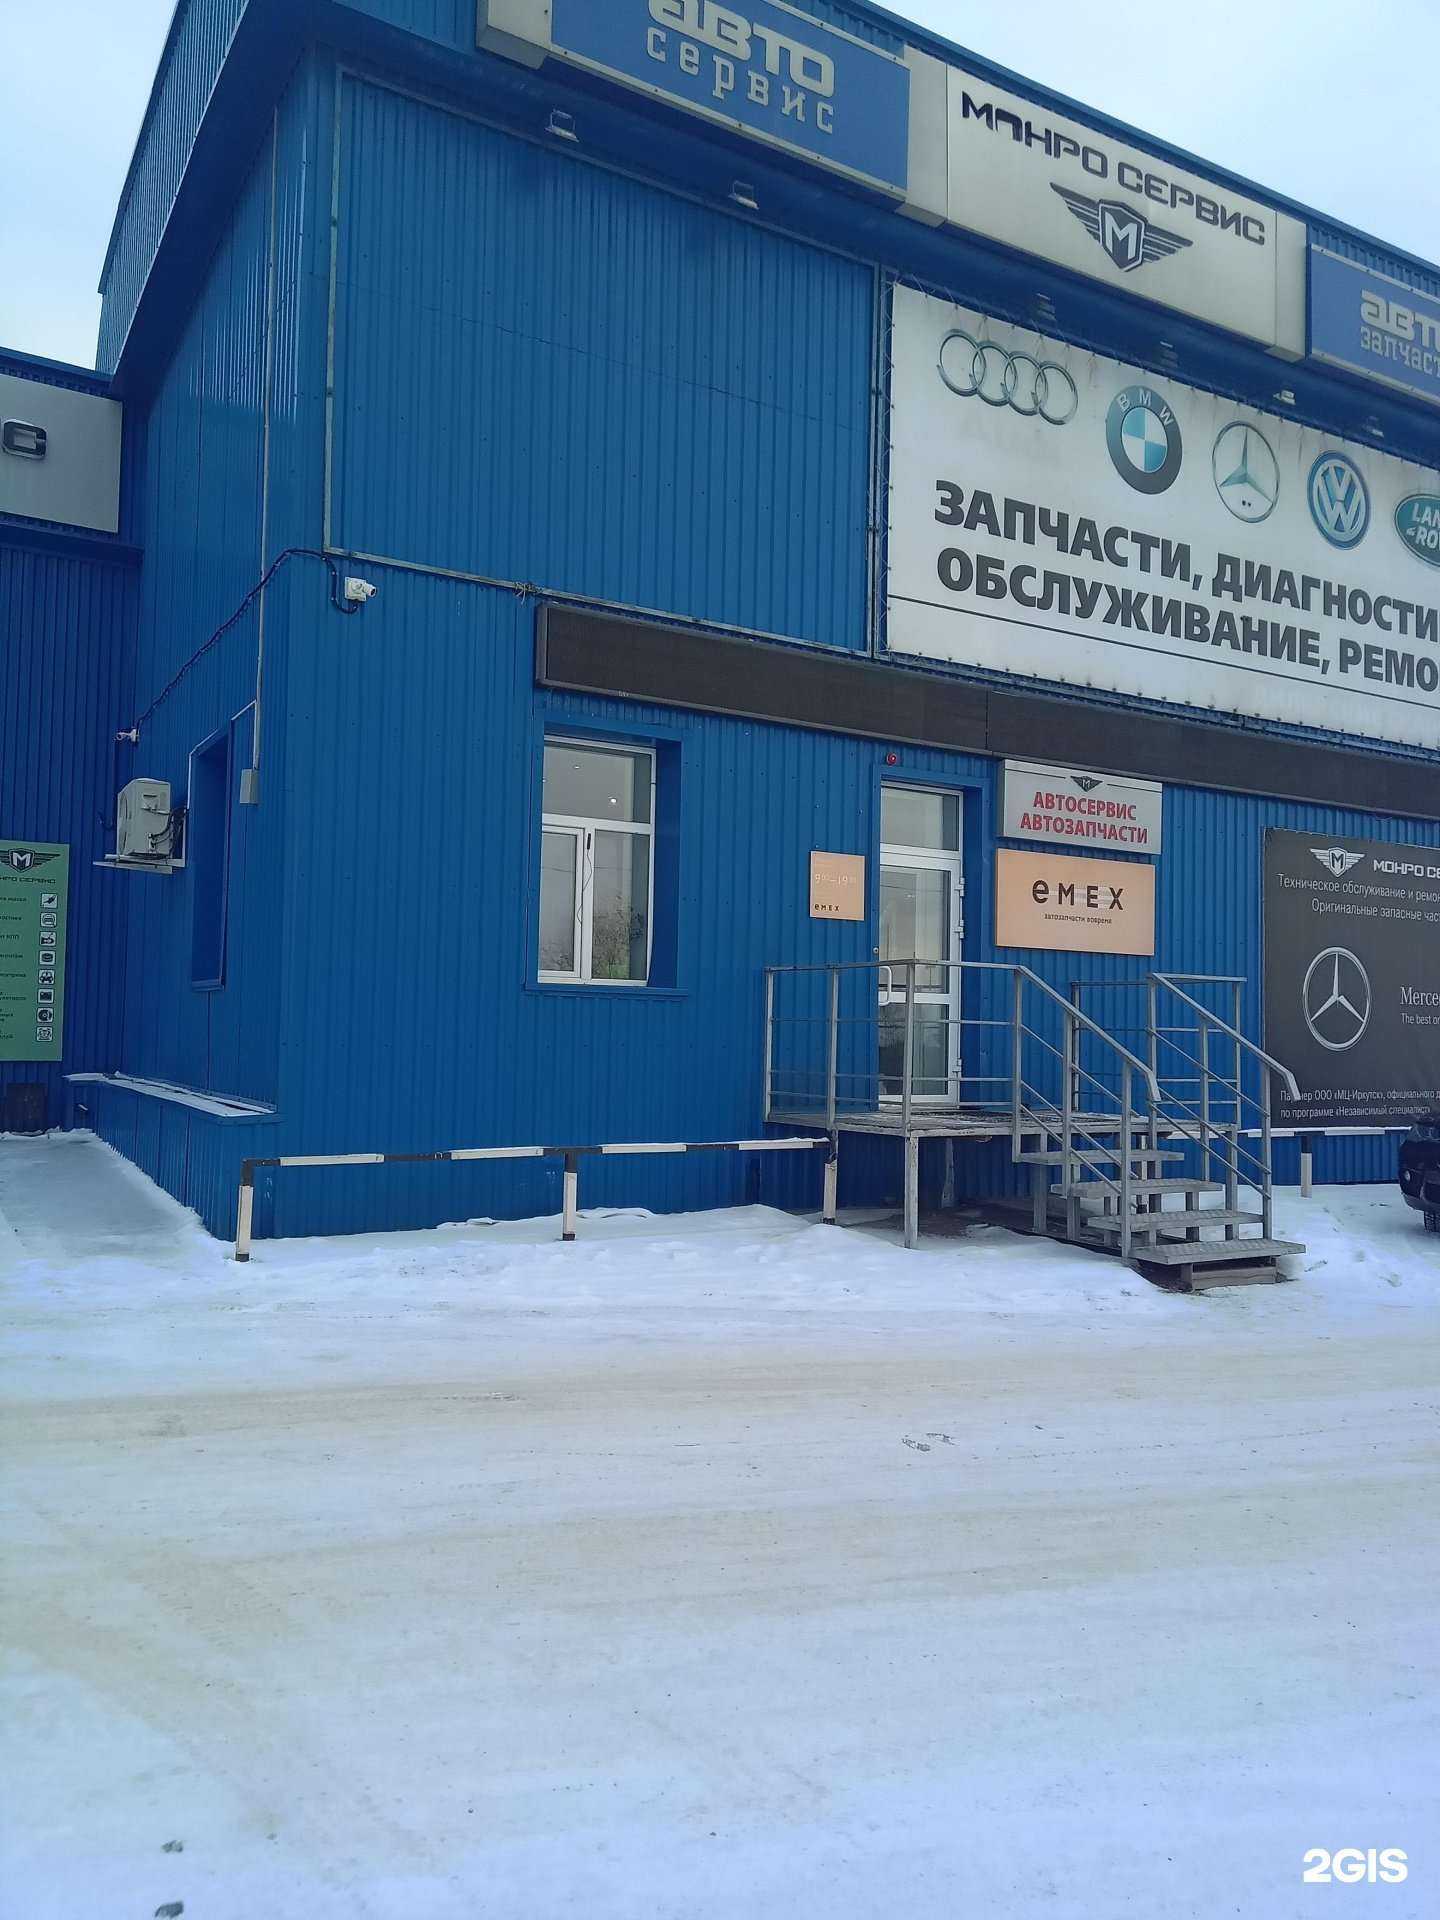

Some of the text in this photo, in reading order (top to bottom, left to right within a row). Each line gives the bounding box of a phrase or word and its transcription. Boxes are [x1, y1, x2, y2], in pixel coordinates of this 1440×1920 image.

[647, 27, 834, 134] сервис
[1117, 161, 1265, 246] СЕРВИС
[1360, 288, 1440, 353] авт
[1117, 388, 1175, 426] BMW
[1415, 525, 1440, 550] RO
[934, 479, 1440, 645] ЗАПЧАСТИ, ДИАГНОСТИ
[937, 547, 1439, 692] ОБСЛУЖИВАНИЕ, РЕМО
[1033, 791, 1137, 821] АВТОСЕРВИС
[1020, 812, 1148, 844] АВТОЗАПЧАСТИ
[1373, 859, 1424, 877] МОНРО
[1277, 873, 1340, 892] Техническое
[1342, 881, 1406, 898] обслуживание
[1408, 889, 1414, 898] и
[1311, 898, 1378, 917] Оригинальные
[1380, 906, 1422, 921] запасные
[1400, 986, 1440, 1006] Merce
[1400, 1012, 1415, 1025] The
[1415, 1013, 1432, 1025] best
[1280, 1090, 1312, 1103] Панер
[1314, 1089, 1333, 1101] ООО
[1280, 1108, 1291, 1119] по
[1292, 1107, 1334, 1119] программе
